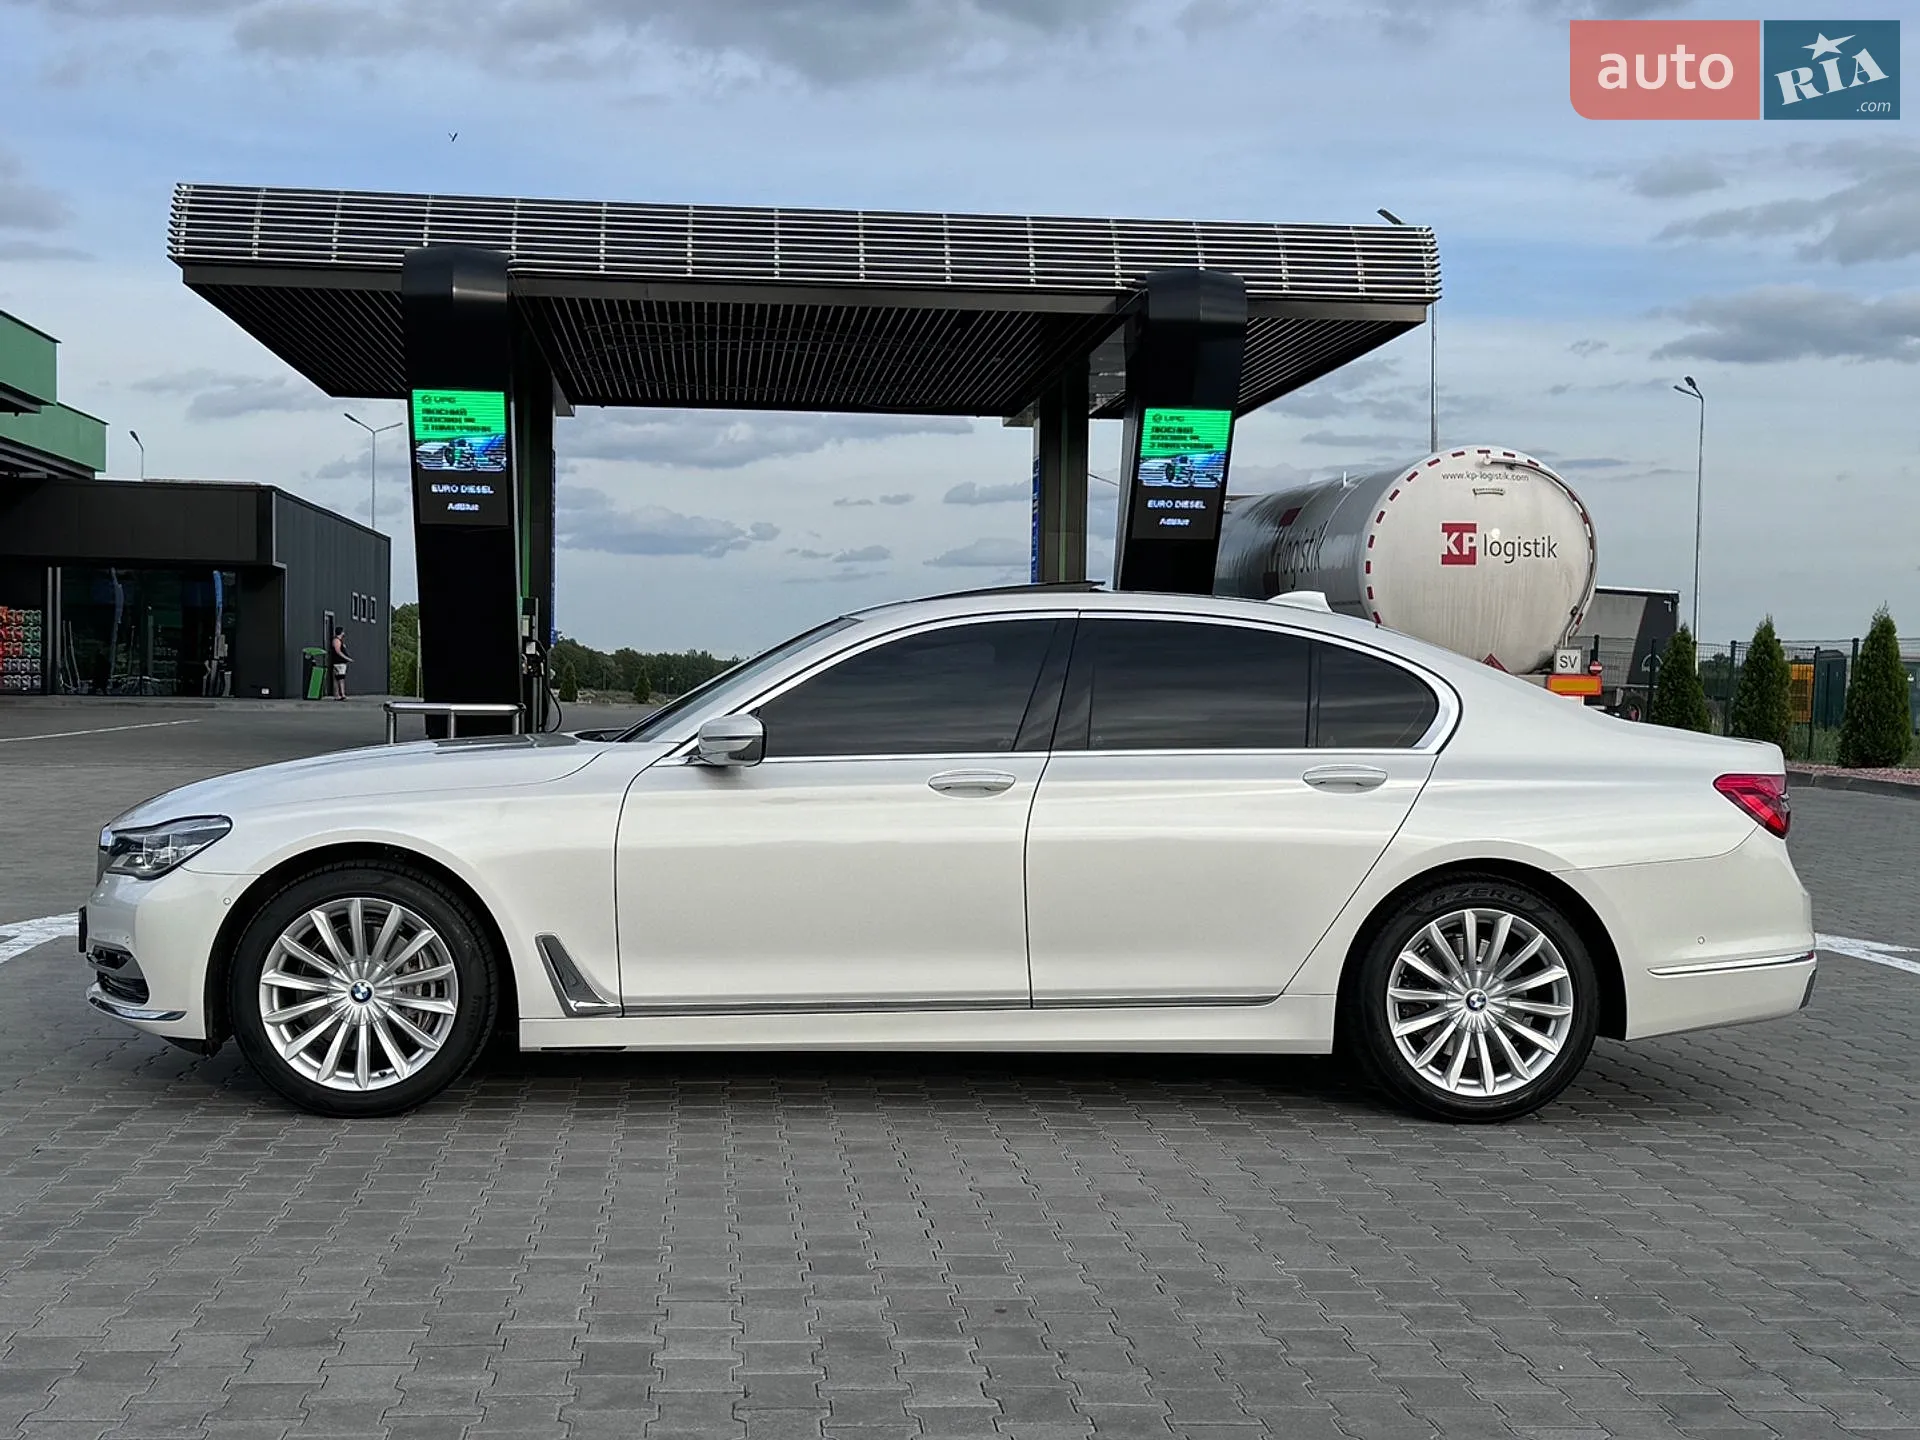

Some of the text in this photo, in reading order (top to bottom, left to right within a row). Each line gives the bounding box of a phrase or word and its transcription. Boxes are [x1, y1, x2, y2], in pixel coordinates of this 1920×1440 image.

[1441, 470, 1530, 483] www.kp-logistik.com
[431, 484, 495, 494] EURO DIESEL
[1147, 499, 1206, 509] EURO DIESEL
[1443, 529, 1558, 564] KP logistik
[1559, 654, 1578, 669] SV
[1454, 887, 1526, 904] ZERO
